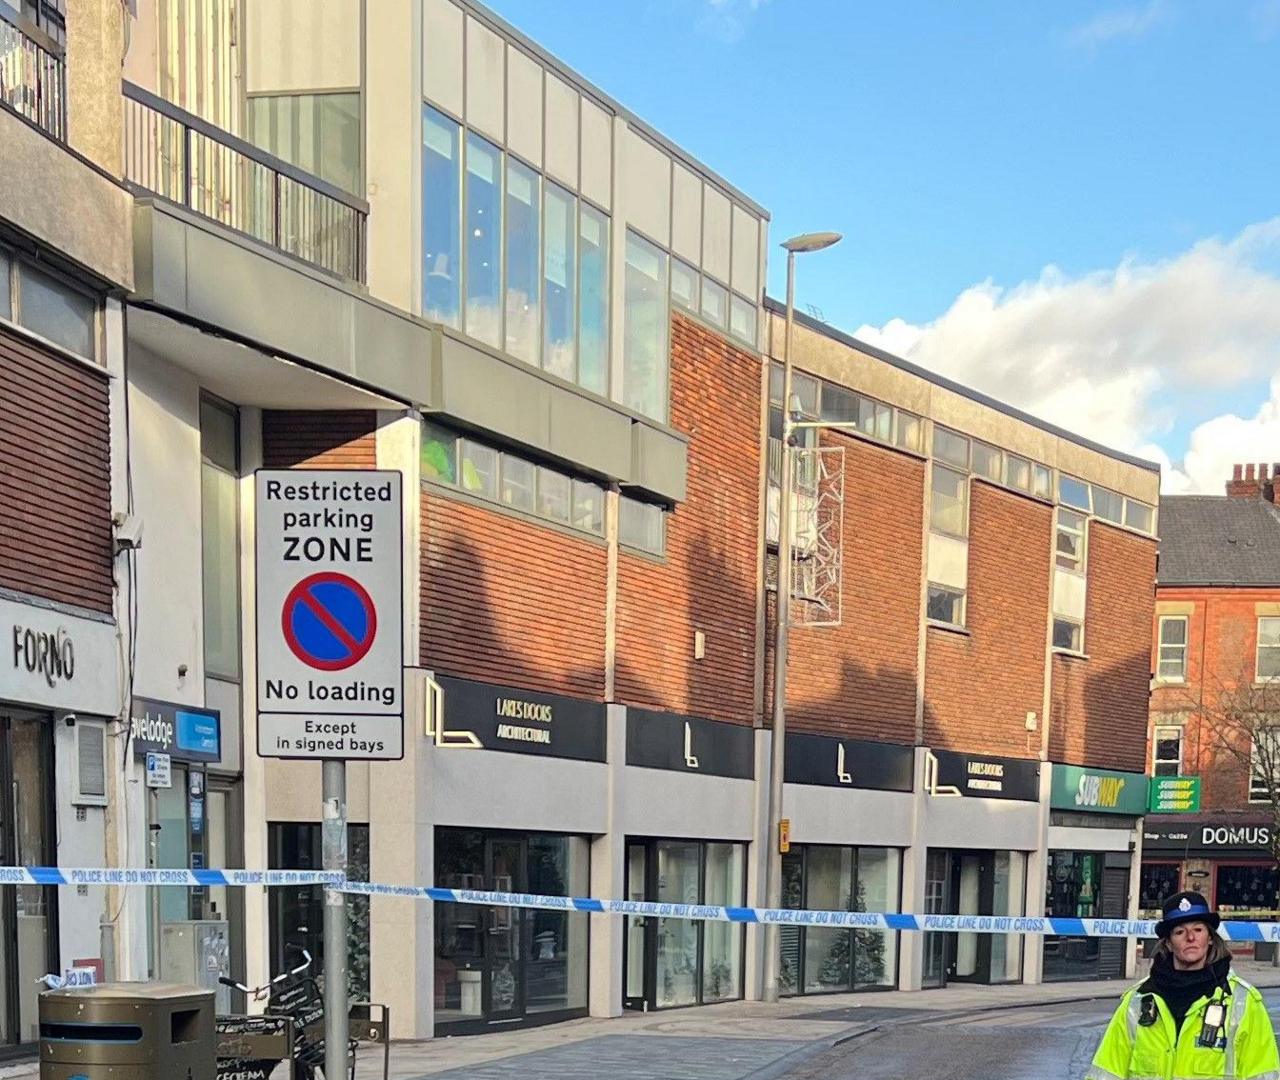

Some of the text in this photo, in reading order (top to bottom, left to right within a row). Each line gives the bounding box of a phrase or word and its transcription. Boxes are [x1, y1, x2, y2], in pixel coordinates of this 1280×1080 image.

[266, 480, 392, 502] Restricted
[283, 508, 374, 532] parking
[282, 536, 374, 562] ZONE
[12, 624, 75, 689] FORNO
[265, 679, 395, 706] No loading
[304, 720, 357, 736] Except
[276, 736, 384, 753] in signed bays
[1074, 774, 1125, 808] SUBWAY
[1157, 779, 1195, 790] SUBWAY
[1157, 789, 1194, 800] SUBWAY
[1156, 800, 1194, 810] SUBWAY
[1201, 826, 1270, 845] DOMUS
[71, 870, 188, 883] POLICE LINE DO NOT CROSS
[233, 871, 346, 884] POLICE LINE DO NOT CROSS
[460, 890, 567, 908] POLICE LINE DO NOT CROSS
[609, 901, 720, 918] POLICE LINE DO NOT CROSS
[763, 910, 878, 926] POLICE LINE DO NOT CROSS
[924, 916, 1046, 932] POLICE LINE DO NOT CROSS
[1092, 920, 1149, 935] POLICE LINE
